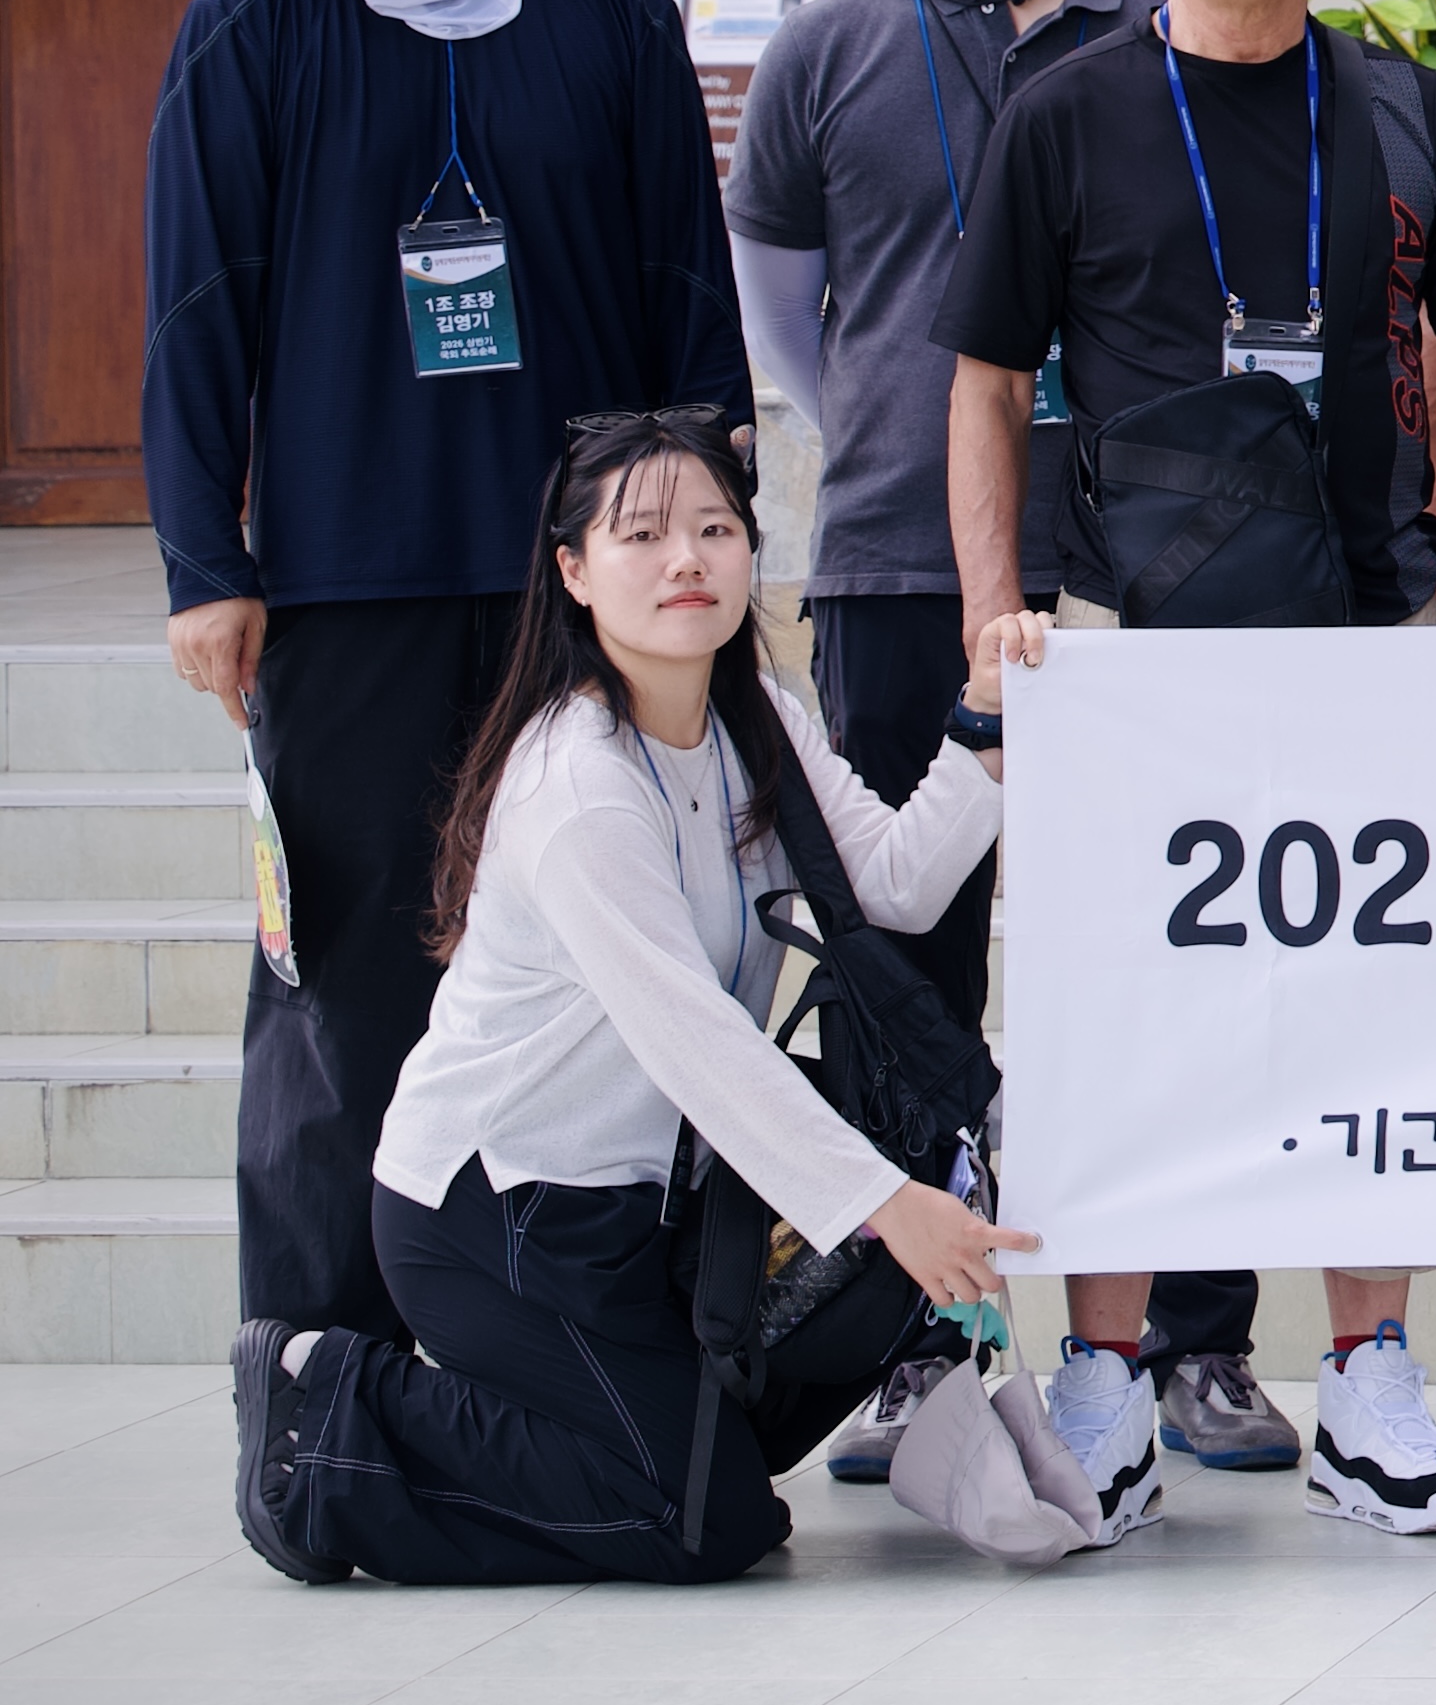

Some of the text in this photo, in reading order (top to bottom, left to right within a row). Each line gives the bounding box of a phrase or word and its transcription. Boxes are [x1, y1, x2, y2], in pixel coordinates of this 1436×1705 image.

[424, 289, 496, 313] 1조 조장
[435, 311, 490, 334] 김영기
[1387, 193, 1429, 444] ALPS
[440, 335, 494, 350] 2026 상반기
